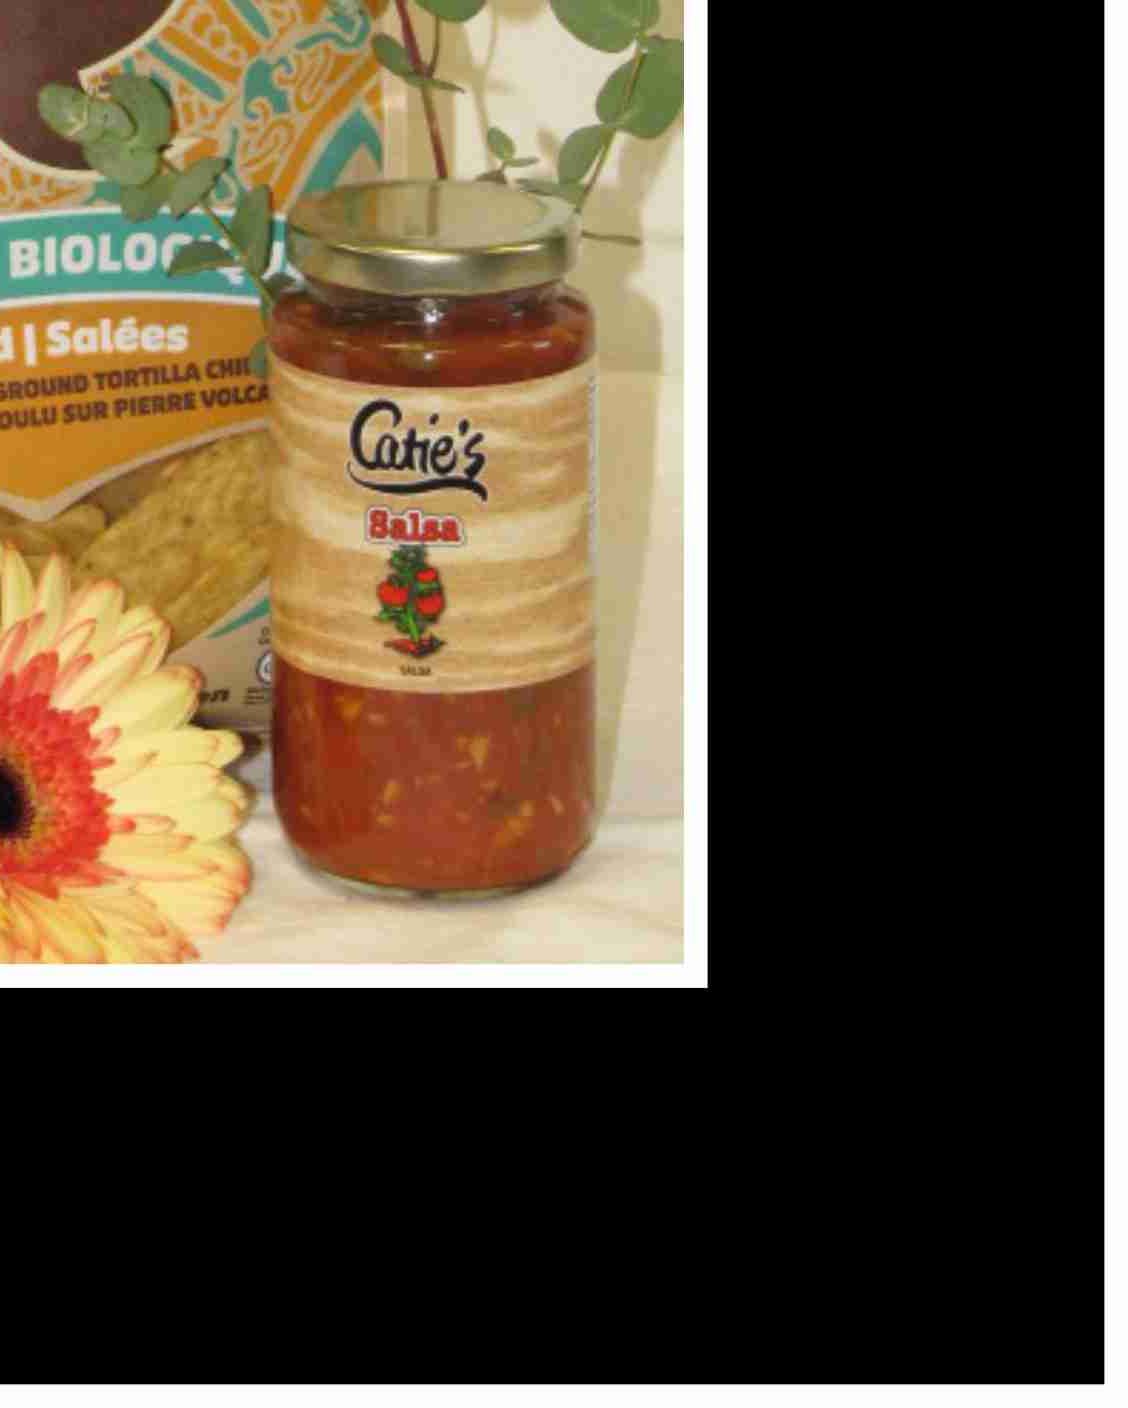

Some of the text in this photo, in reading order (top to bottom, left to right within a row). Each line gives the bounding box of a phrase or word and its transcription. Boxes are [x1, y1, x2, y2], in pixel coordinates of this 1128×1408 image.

[45, 317, 189, 359] Salées
[93, 362, 201, 391] TORTILLA
[204, 356, 252, 380] CHI
[62, 400, 108, 425] SUR
[114, 391, 197, 419] PIERRE
[349, 399, 486, 480] Catie's
[366, 507, 462, 544] Salsa
